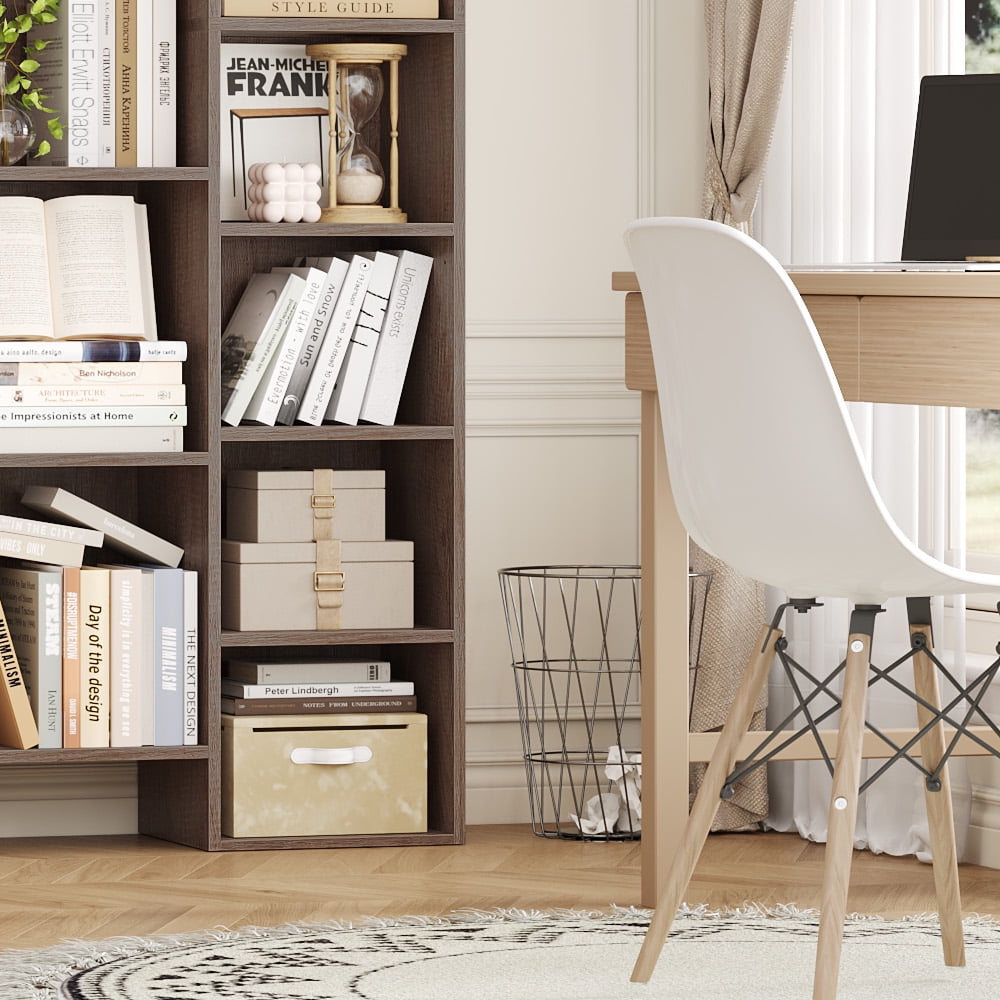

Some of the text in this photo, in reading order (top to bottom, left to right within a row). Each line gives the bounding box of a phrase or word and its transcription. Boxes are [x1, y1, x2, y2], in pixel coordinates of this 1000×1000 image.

[271, 1, 395, 14] STYLE GUIDE
[68, 3, 95, 147] Elliott Erwitt Snaps
[102, 47, 111, 126] СТИХОТВОРЕНИЯ
[158, 41, 170, 106] ФРИДРИХ ЭНГЕЛЬС
[226, 57, 330, 72] JEAN-MICHE
[297, 309, 308, 333] with
[302, 281, 320, 305] love
[390, 267, 417, 339] Unicorns exists
[299, 283, 336, 367] Sun and Snow
[38, 389, 106, 397] ARCHITECTURE
[79, 369, 136, 377] Ben Nicholson
[267, 348, 296, 405] Evermotion
[10, 412, 87, 423] Impressionists
[90, 413, 101, 421] at
[104, 412, 134, 421] Home
[0, 537, 22, 554] VIBES
[27, 542, 46, 556] ONLY
[9, 520, 23, 532] IN
[26, 522, 47, 535] THE
[50, 527, 75, 539] CITY
[44, 583, 60, 656] STEAM
[66, 591, 78, 660] #DISRUPTMENOW
[85, 604, 103, 722] Day of the design
[120, 580, 133, 737] simplicity is in everything we see
[161, 626, 177, 691] MINIMALISM
[186, 629, 196, 737] THE NEXT DESIGN
[47, 690, 57, 733] IAN HUNT
[265, 686, 339, 696] Peter Lindbergh
